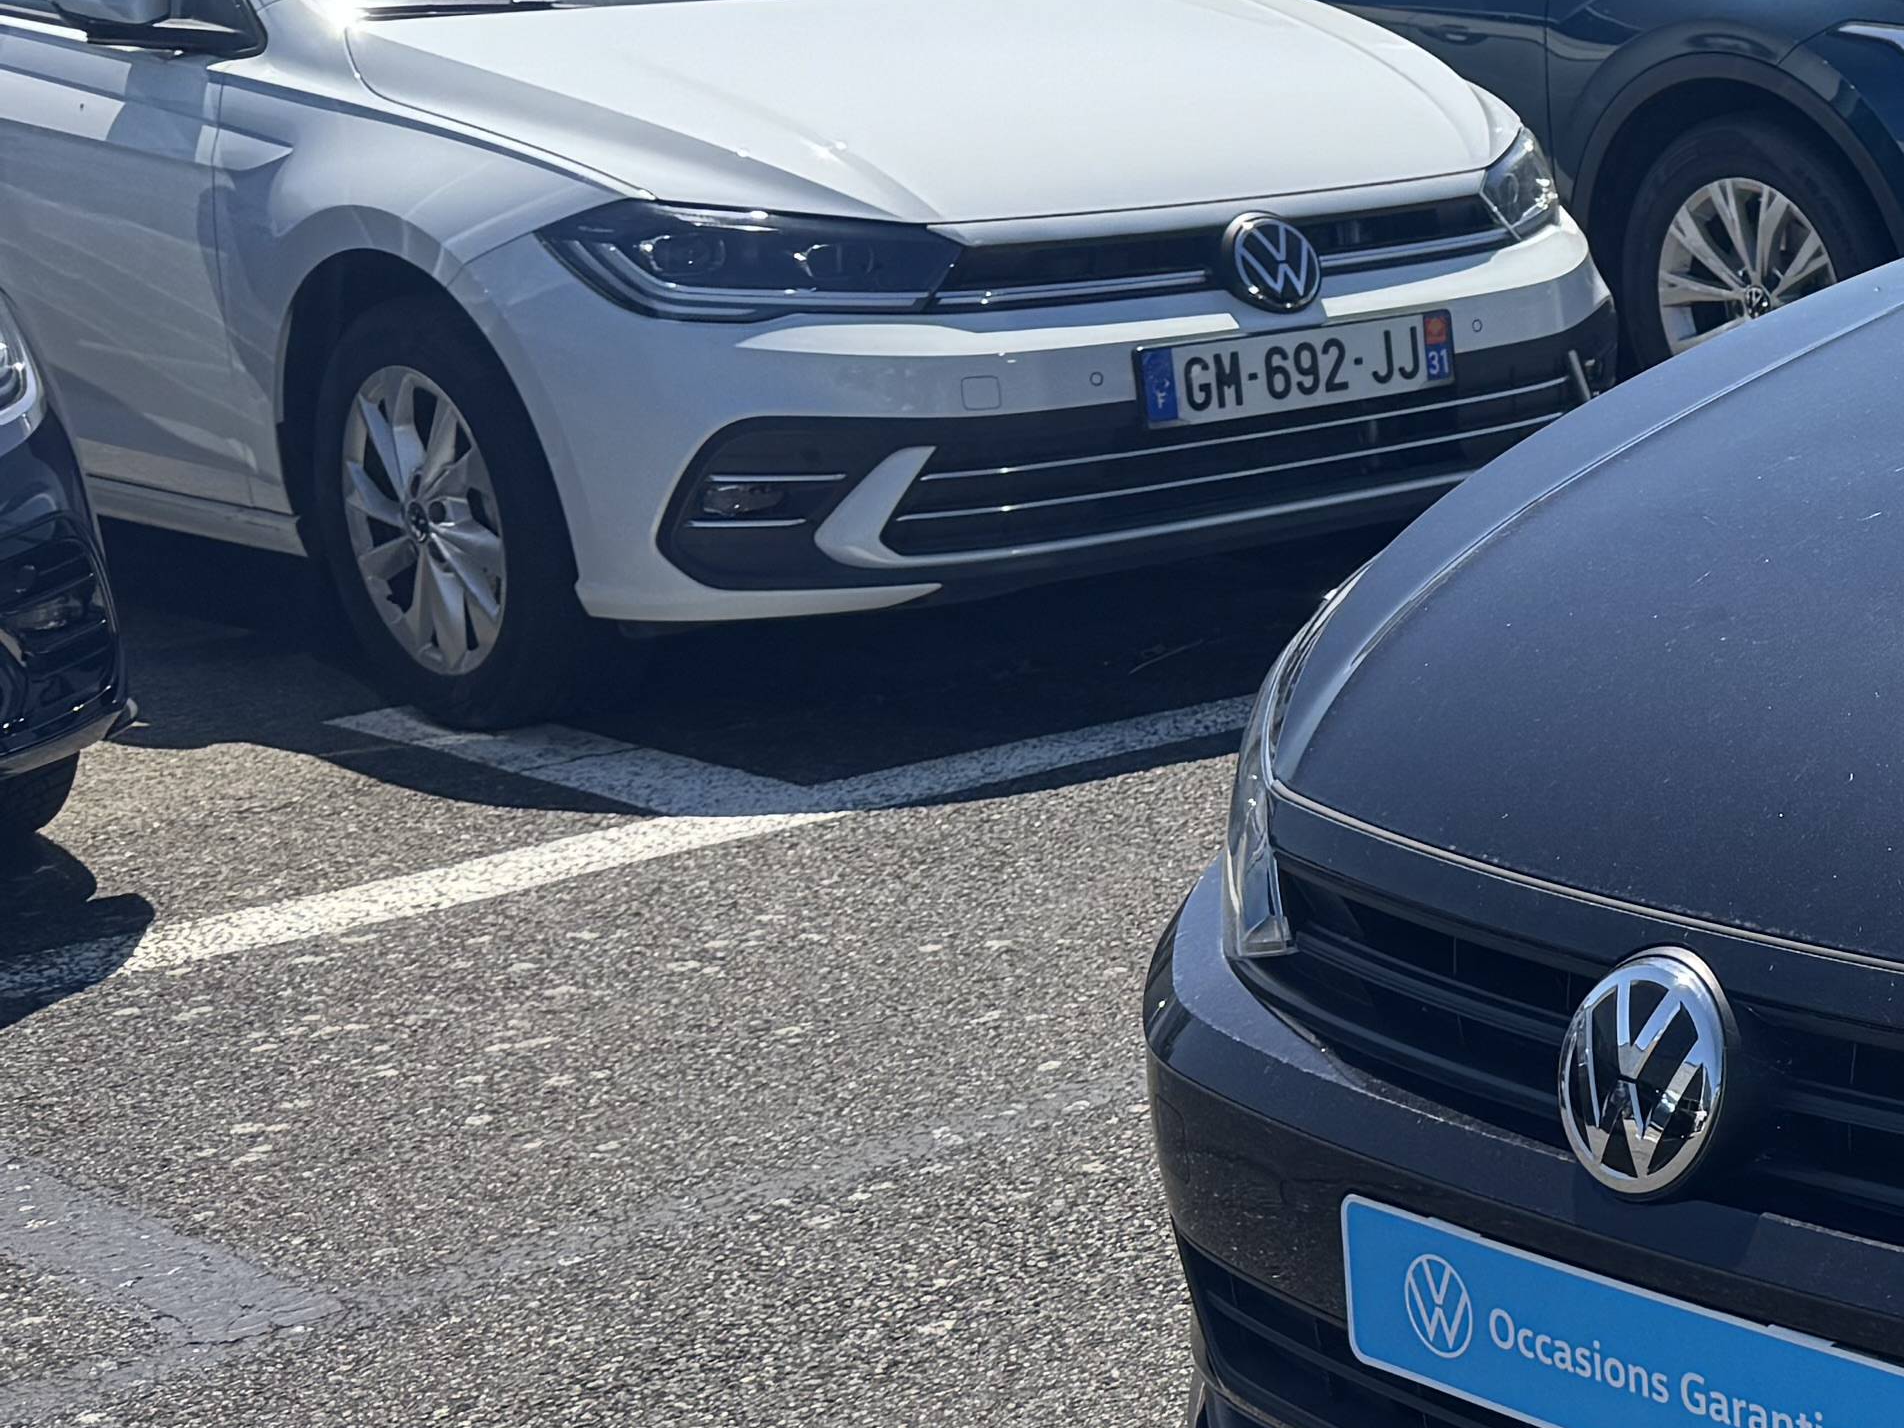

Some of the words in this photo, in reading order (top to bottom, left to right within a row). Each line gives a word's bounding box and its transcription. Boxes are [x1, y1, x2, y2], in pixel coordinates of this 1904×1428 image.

[1183, 325, 1422, 413] GM-692-JJ
[1427, 349, 1449, 375] 31
[1488, 1307, 1670, 1404] Occasions
